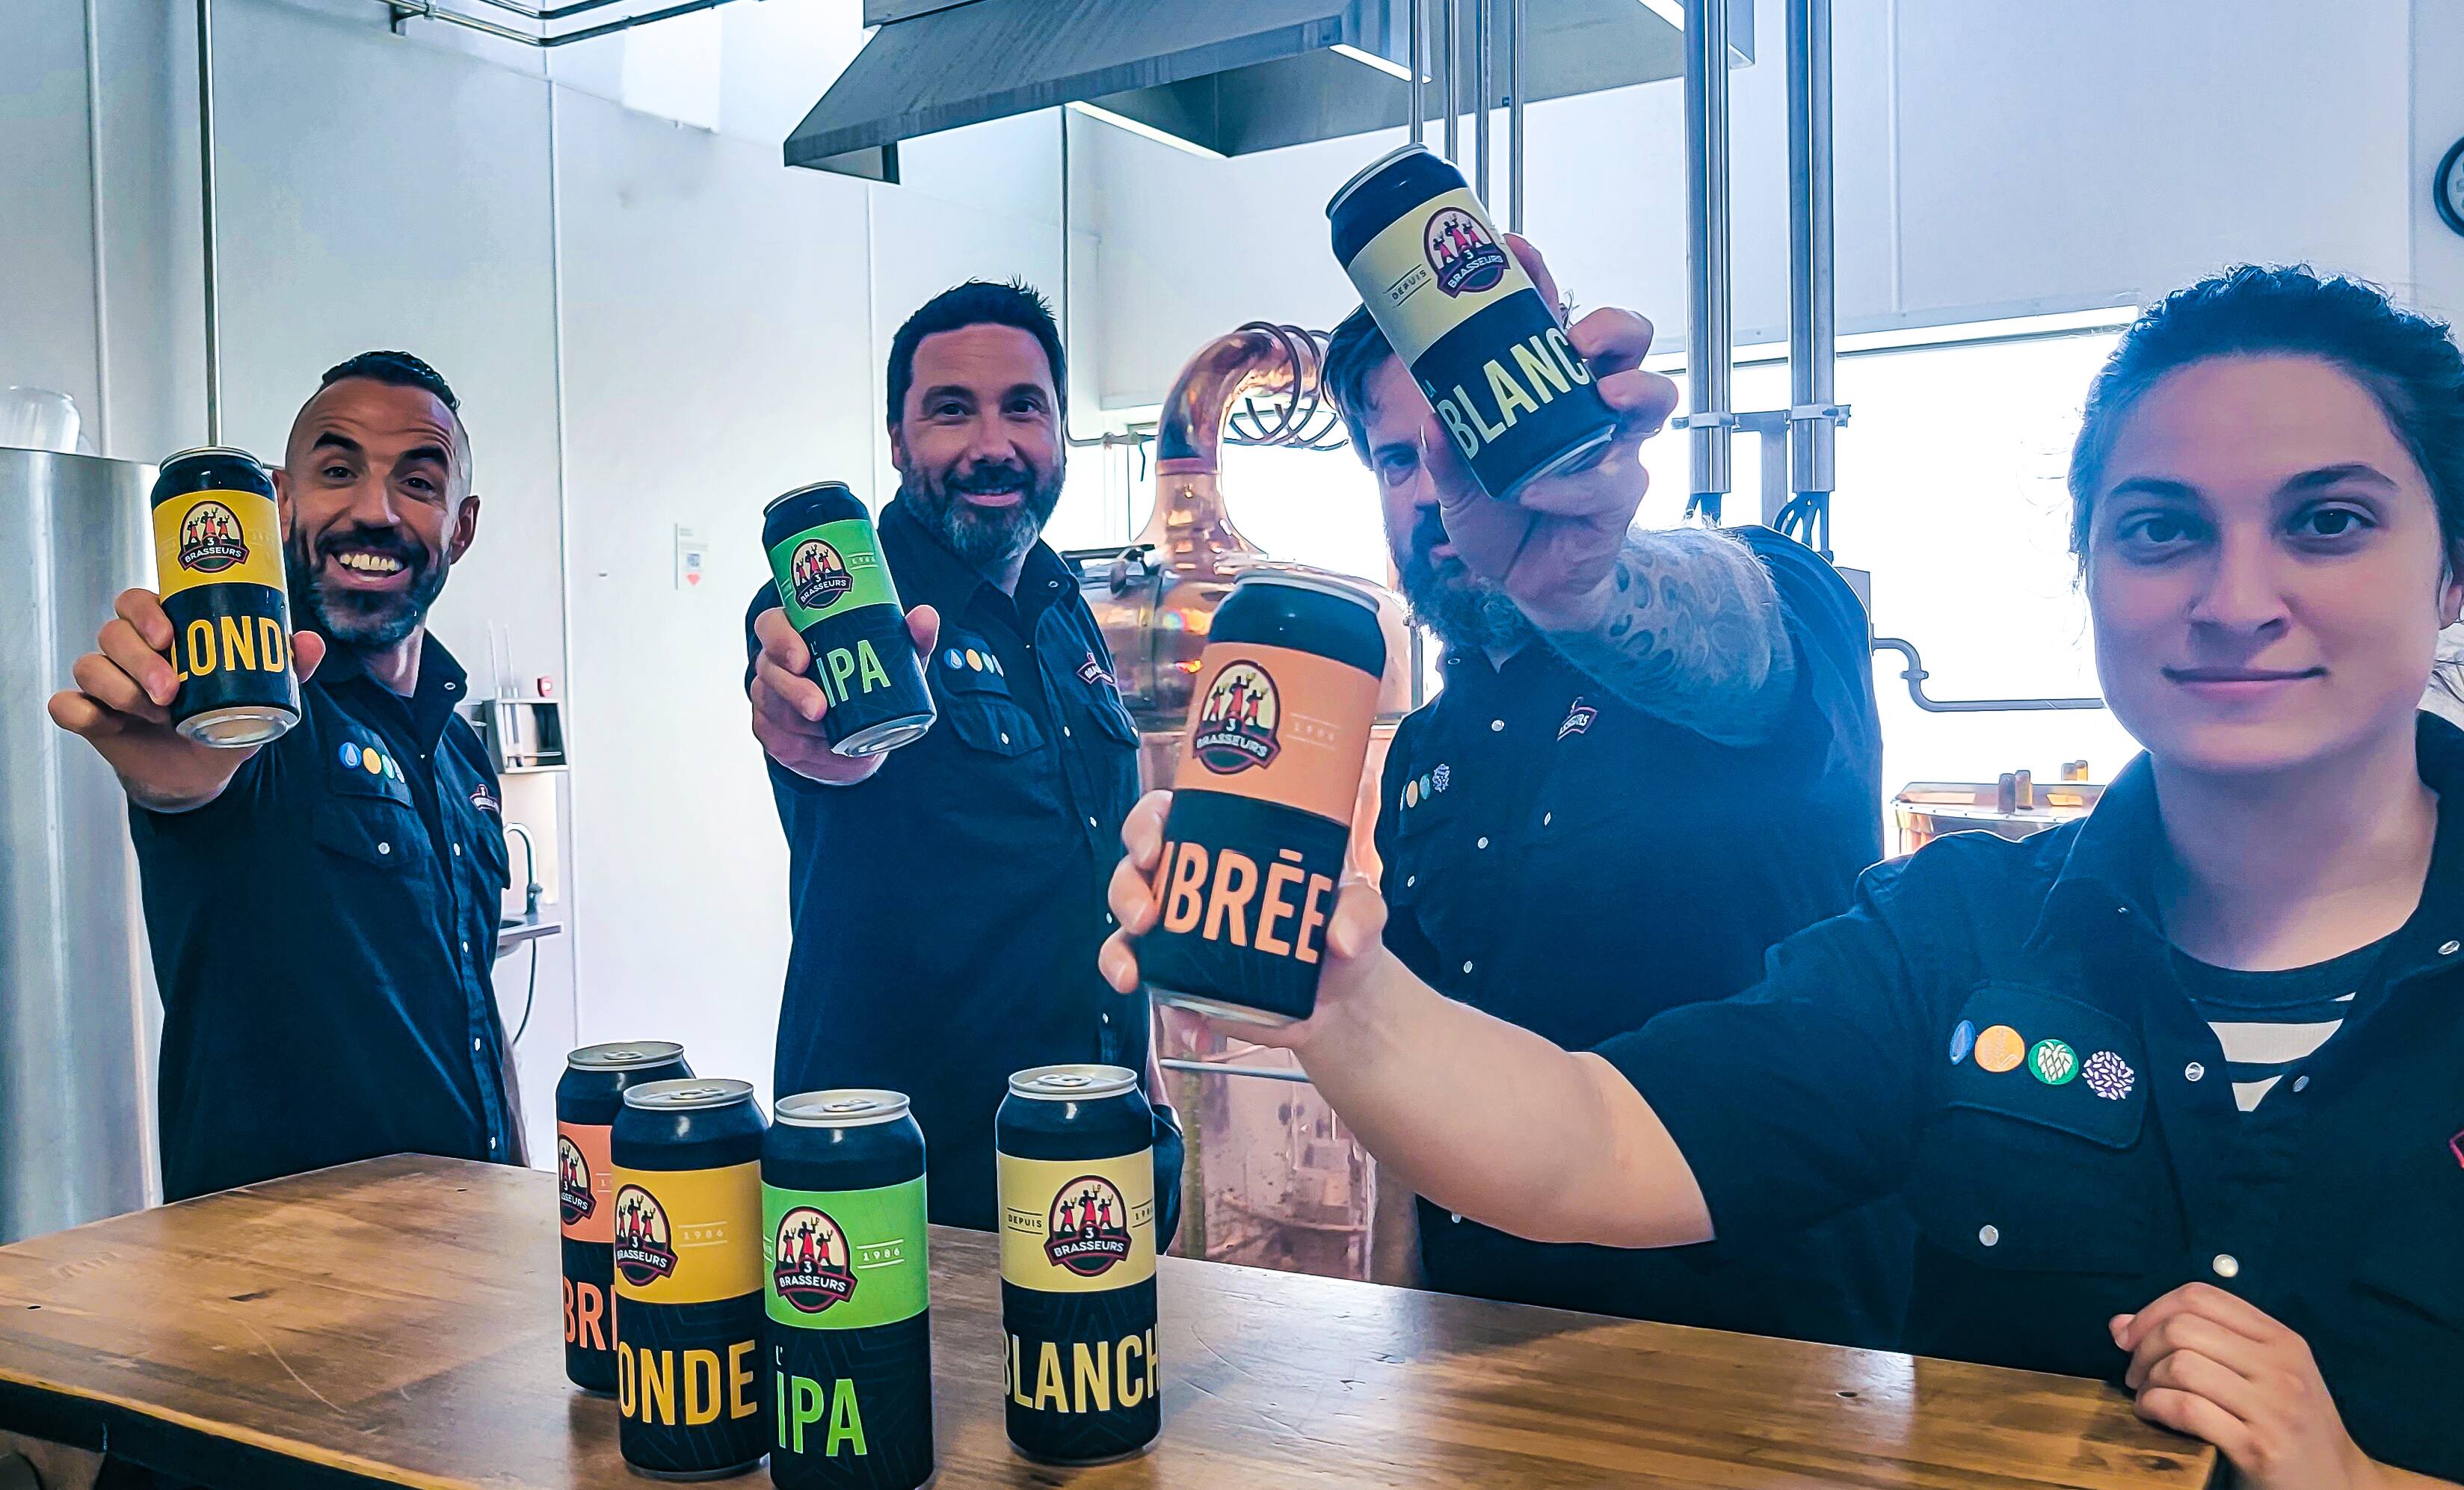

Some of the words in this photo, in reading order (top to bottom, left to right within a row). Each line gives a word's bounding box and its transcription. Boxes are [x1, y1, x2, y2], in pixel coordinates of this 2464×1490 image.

[1391, 269, 1427, 301] DEPUIS
[1436, 327, 1590, 461] BLANC
[207, 537, 215, 546] 3
[185, 547, 242, 563] BRASSEURS
[814, 573, 822, 582] 3
[816, 639, 891, 708] IPA
[1008, 1213, 1043, 1228] DEPUIS
[683, 1229, 724, 1240] 1986
[1085, 1227, 1094, 1239] 3
[632, 1236, 638, 1249] 3
[1053, 1240, 1124, 1257] BRASSEURS
[863, 1247, 900, 1262] 1986
[804, 1260, 813, 1273] 3
[779, 1275, 846, 1293] BRASSEURS
[618, 1339, 757, 1426] ONDE
[777, 1370, 868, 1457] IPA
